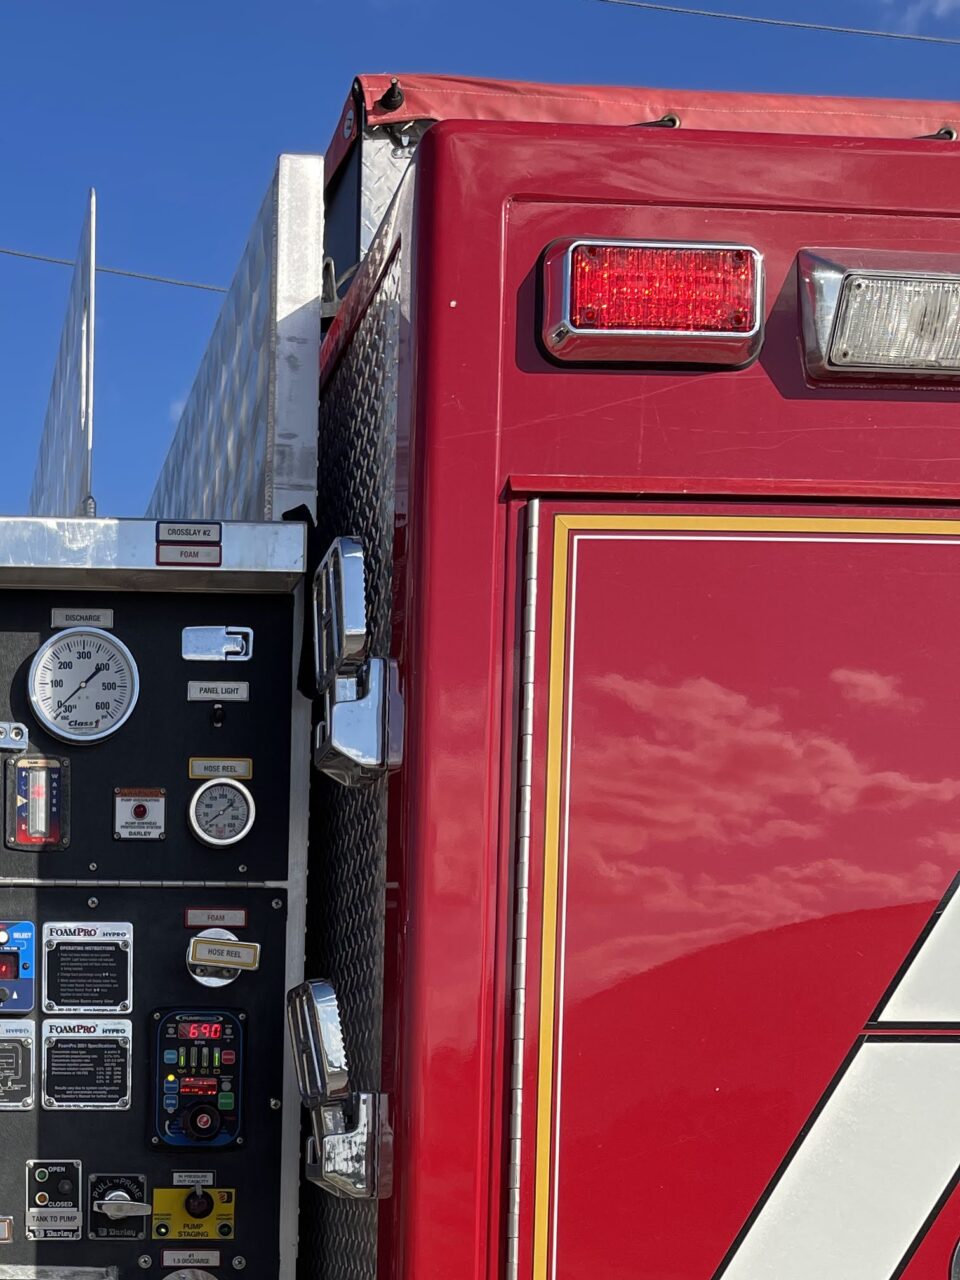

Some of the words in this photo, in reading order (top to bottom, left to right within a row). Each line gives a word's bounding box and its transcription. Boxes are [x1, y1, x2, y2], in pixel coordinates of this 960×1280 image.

[168, 529, 200, 537] CROSSLAY
[180, 551, 199, 559] FOAM
[76, 652, 92, 660] 300
[58, 662, 73, 670] 200
[95, 663, 110, 672] 400
[50, 680, 64, 688] 100
[102, 682, 117, 691] 500
[200, 687, 220, 695] PANEL
[222, 687, 240, 695] LIGHT
[96, 704, 110, 712] 600
[204, 764, 221, 773] HOSE
[222, 765, 238, 773] REEL
[52, 774, 60, 812] WATER
[208, 948, 224, 957] HOSE
[226, 950, 241, 958] REEL
[189, 1024, 221, 1038] 690
[92, 1180, 112, 1198] PULL
[120, 1178, 143, 1199] PRIME
